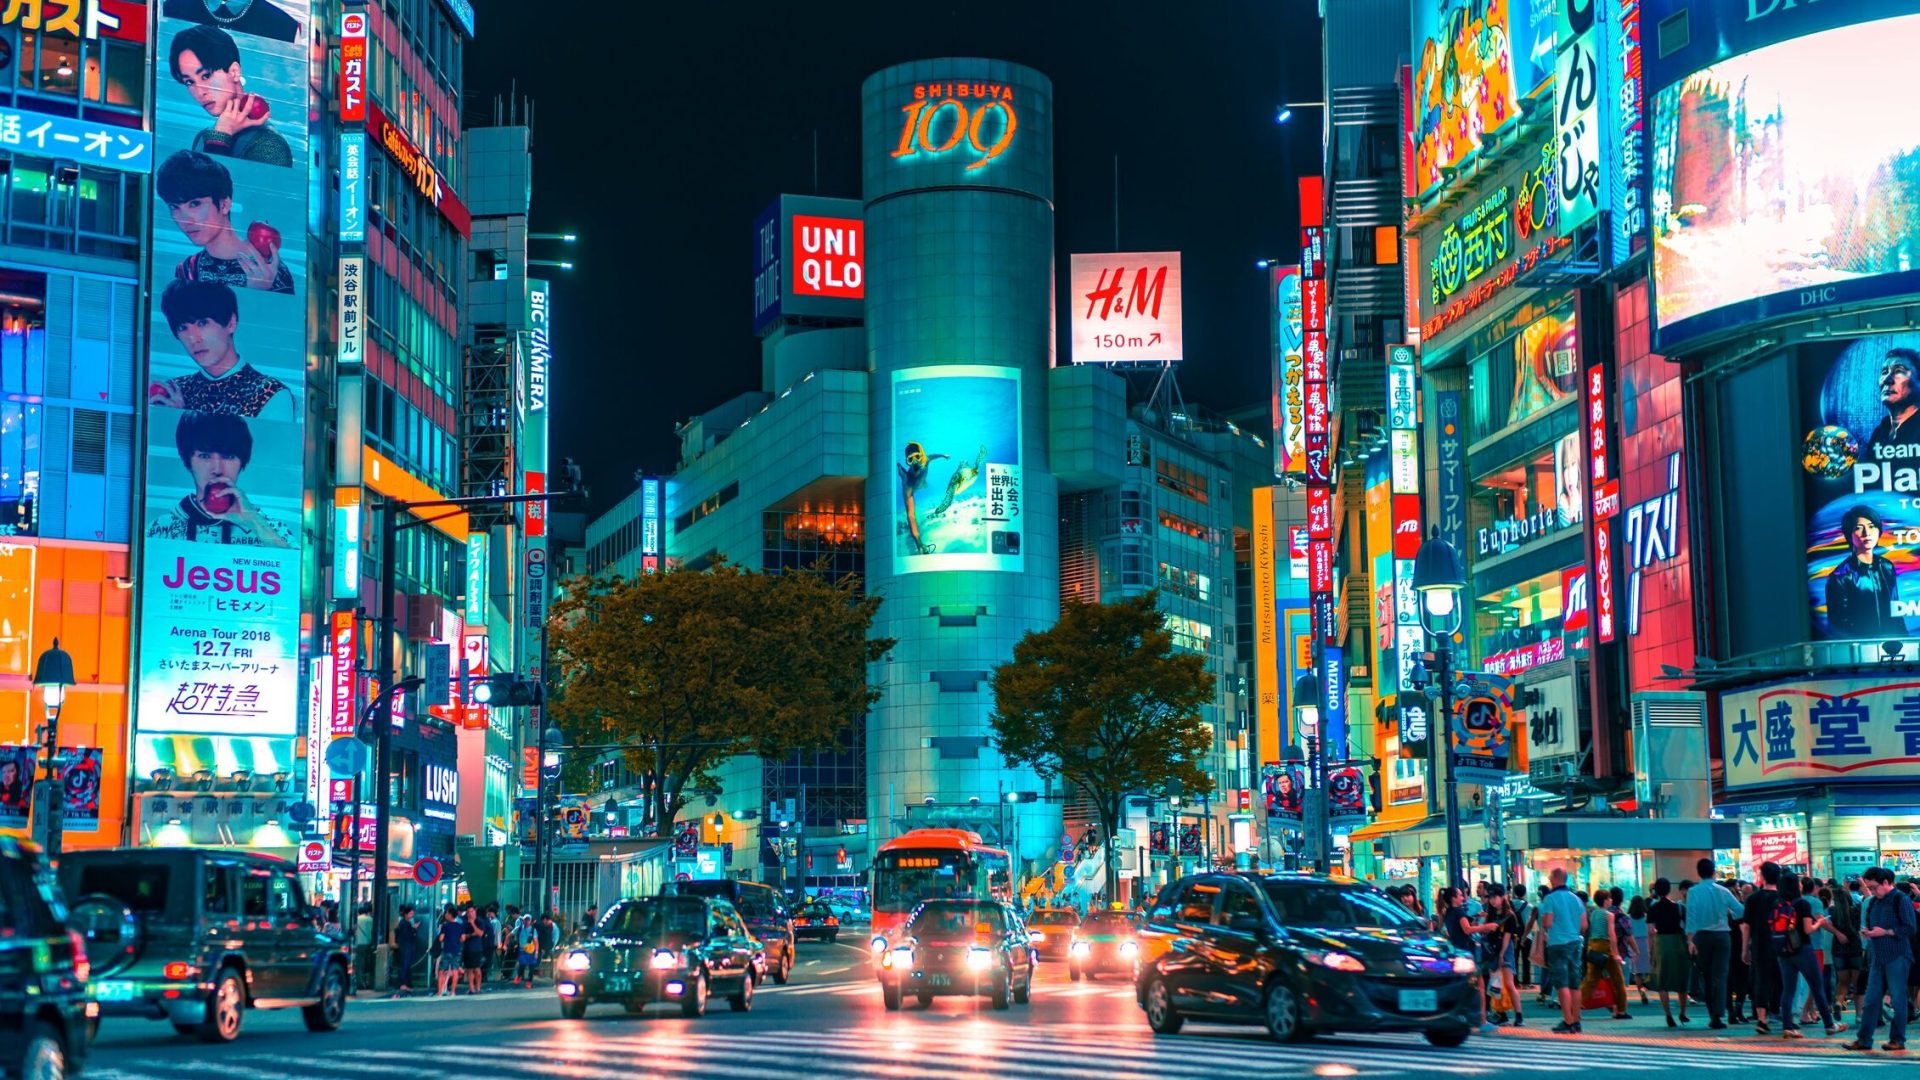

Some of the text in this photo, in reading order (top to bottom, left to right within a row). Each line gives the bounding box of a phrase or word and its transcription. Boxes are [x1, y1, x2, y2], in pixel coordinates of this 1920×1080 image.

[346, 59, 361, 110] ガスト
[914, 84, 1013, 100] SHIBUYA
[890, 98, 1018, 170] 109
[417, 154, 442, 207] ガスト
[760, 219, 774, 267] THE
[802, 226, 856, 256] UNI
[802, 258, 862, 290] QLO
[343, 263, 359, 353] 渋谷駅前ビル
[1085, 266, 1167, 321] H&M
[1800, 287, 1836, 306] DHC
[531, 291, 552, 411] BIC CAMERA
[991, 475, 1019, 487] 世界に
[1853, 461, 1920, 494] Pla
[1397, 518, 1419, 533] JTB
[1479, 506, 1554, 555] Euphoria
[162, 556, 281, 595] Jesus
[233, 558, 281, 568] NEW SINGLE
[216, 597, 266, 612] ヒモメン
[529, 550, 544, 628] OS 調剤薬局
[1261, 572, 1272, 644] Matsumoto
[170, 625, 271, 642] Arena Tour 2018
[192, 640, 253, 659] 12.7 FRI
[159, 658, 280, 675] さいたまスーパーアリーナ
[1328, 660, 1339, 710] MIZUHO
[165, 682, 268, 717] 超特急
[335, 645, 352, 726] サンドラッグ
[1407, 706, 1427, 743] HUB
[426, 764, 458, 806] LUSH
[1740, 804, 1769, 812] TAISEIDO
